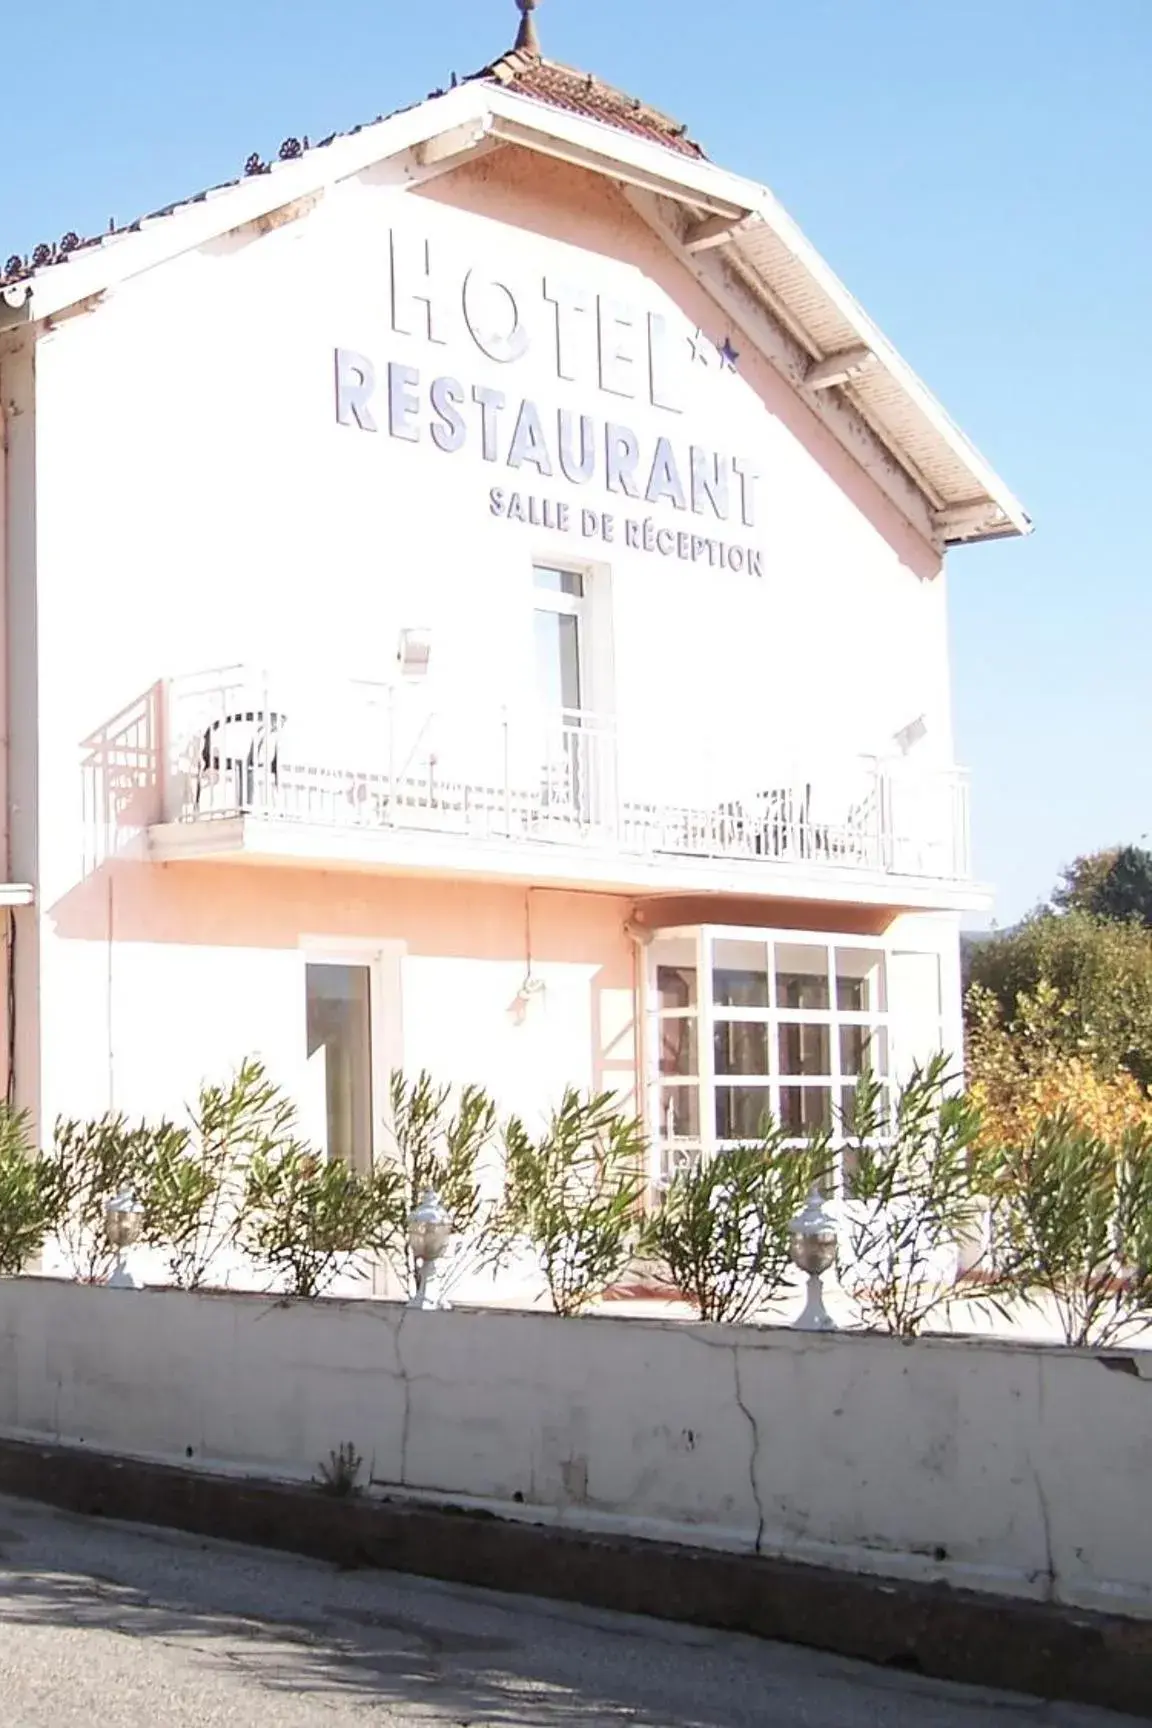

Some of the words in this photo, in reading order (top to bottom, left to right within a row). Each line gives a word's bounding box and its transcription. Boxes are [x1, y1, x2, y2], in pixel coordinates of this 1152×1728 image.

[389, 227, 684, 413] HOTEL
[334, 346, 763, 528] RESTAURANT
[489, 486, 570, 532] SALLE
[581, 508, 615, 543] DE
[625, 515, 763, 578] RÉCEPTION
